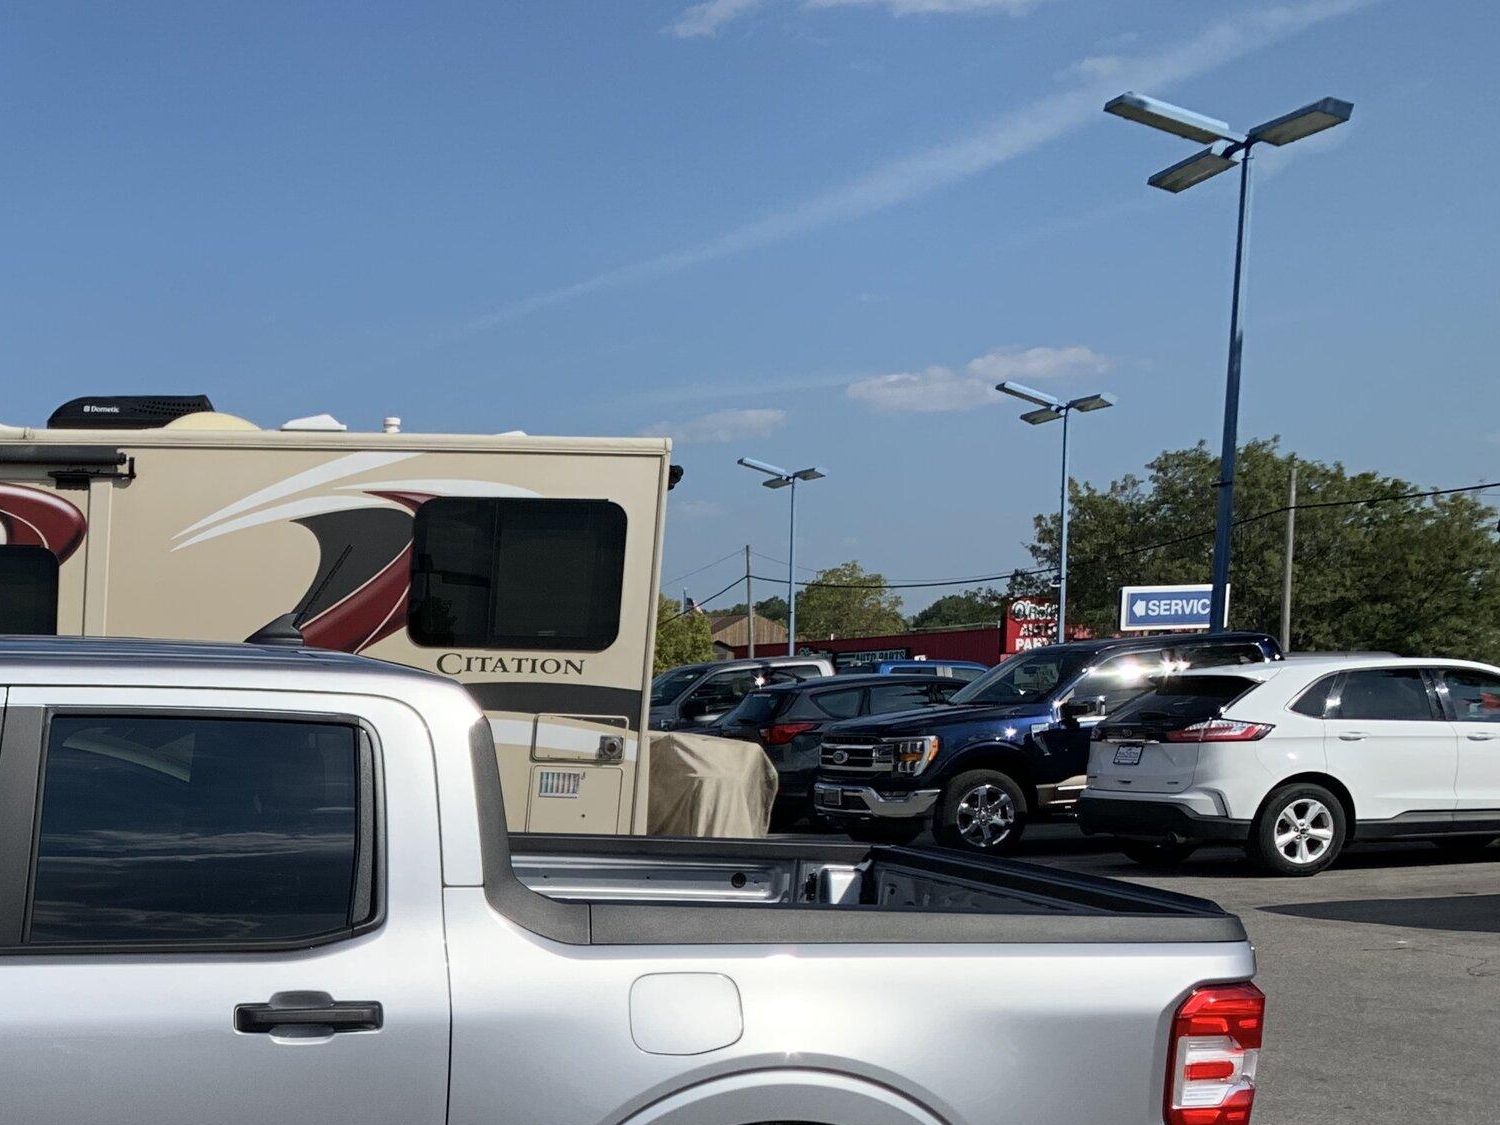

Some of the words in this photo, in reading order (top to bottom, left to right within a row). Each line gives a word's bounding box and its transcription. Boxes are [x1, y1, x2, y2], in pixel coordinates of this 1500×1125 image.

[90, 405, 120, 413] Dometic
[1147, 598, 1212, 616] SERVIC
[436, 652, 585, 676] CITATION
